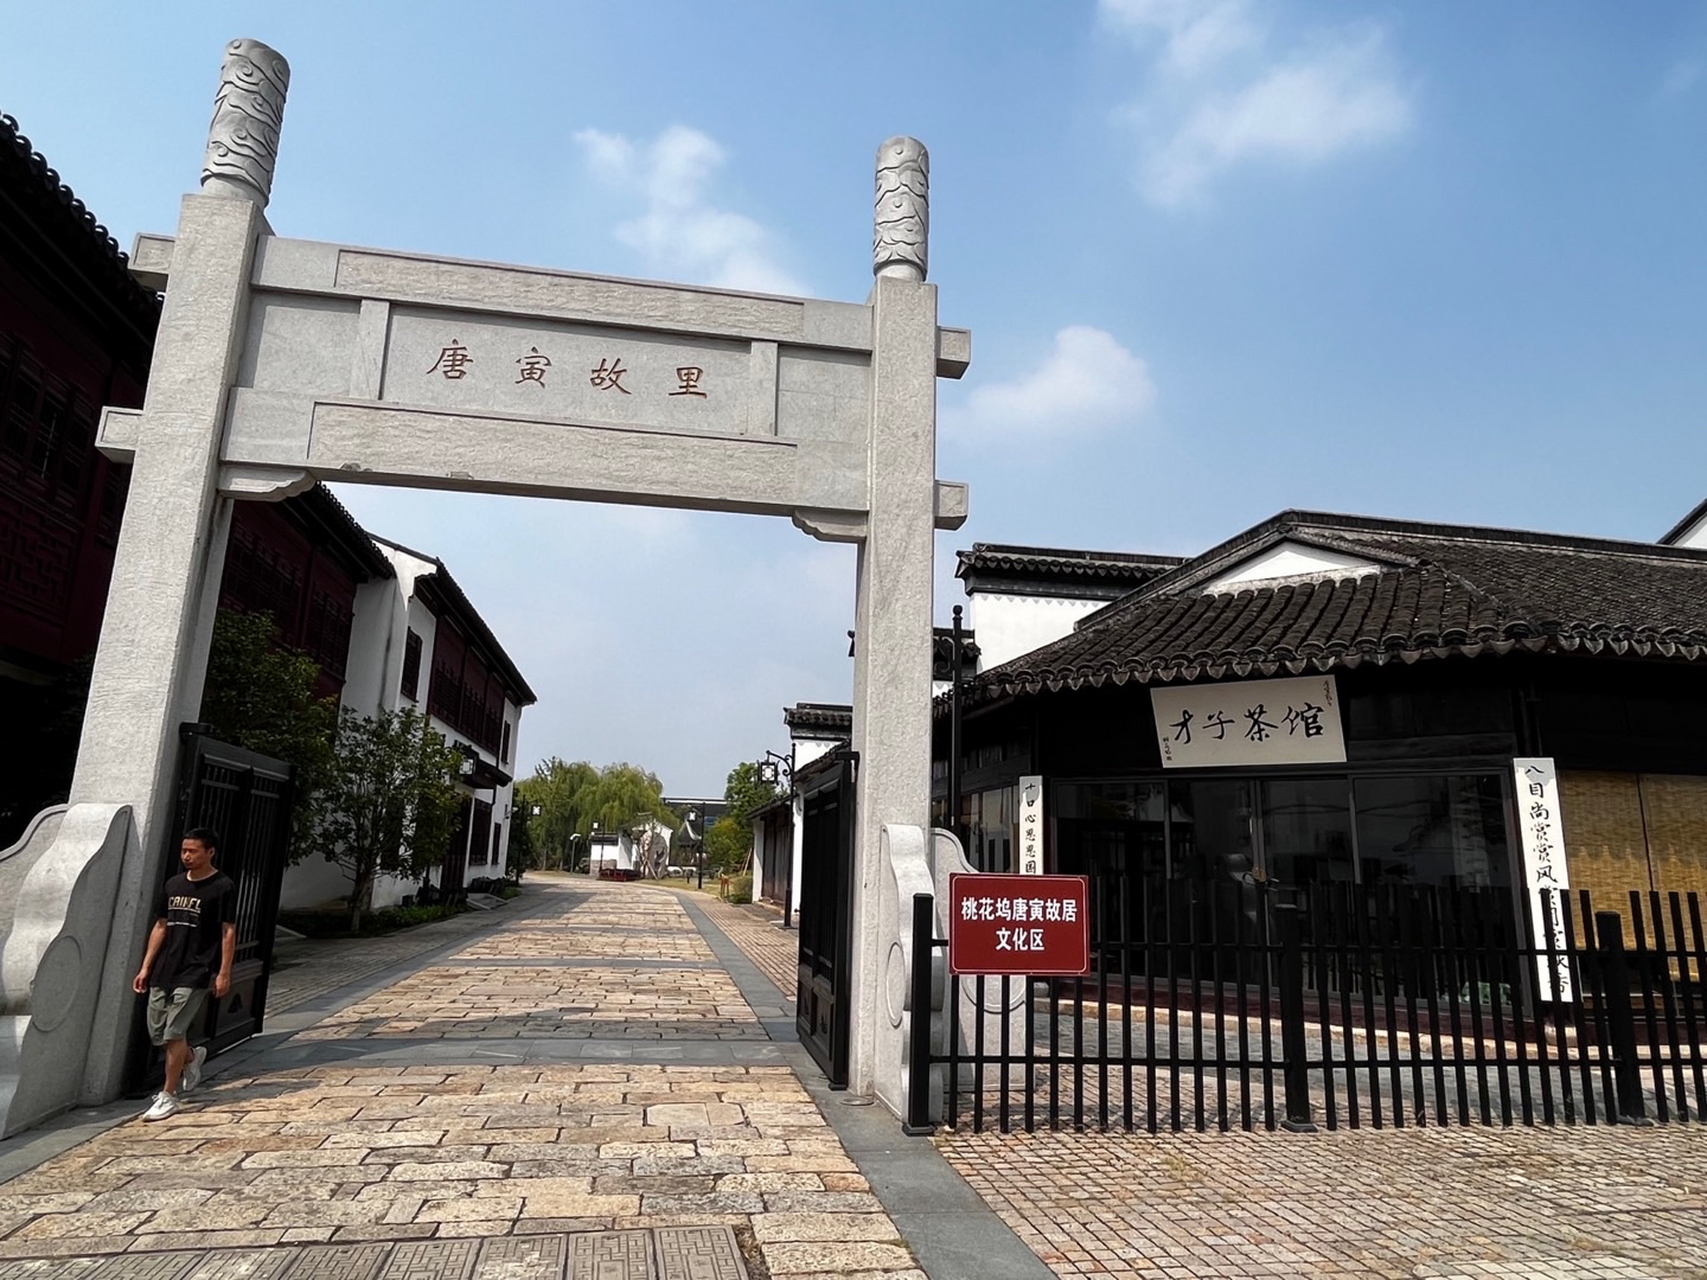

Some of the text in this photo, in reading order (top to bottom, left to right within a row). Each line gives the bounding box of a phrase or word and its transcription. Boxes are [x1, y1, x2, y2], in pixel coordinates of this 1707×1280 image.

[426, 338, 708, 399] 唐寅故里
[1169, 702, 1325, 745] 才子茶馆
[961, 896, 1077, 922] 桃花坞唐寅故居
[995, 927, 1045, 951] 文化区
